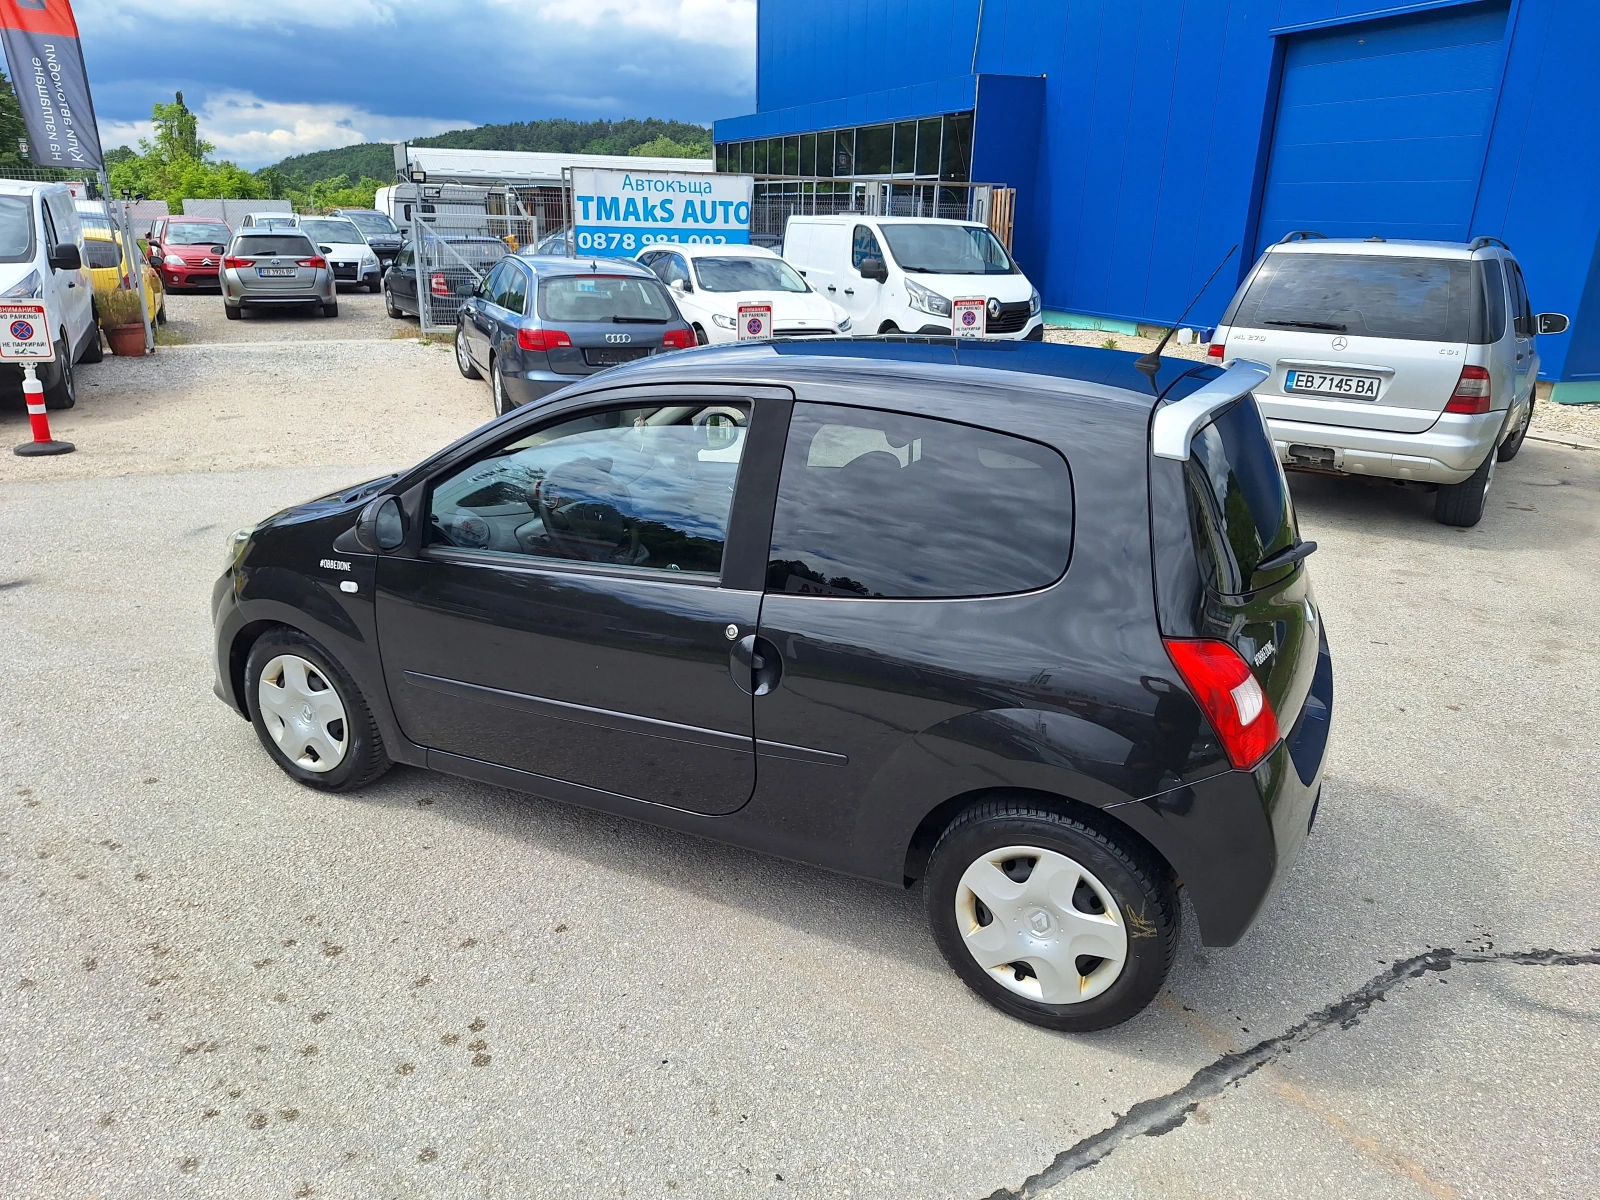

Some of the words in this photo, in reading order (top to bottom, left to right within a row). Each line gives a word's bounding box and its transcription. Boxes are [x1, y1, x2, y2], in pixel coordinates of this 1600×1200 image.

[622, 174, 712, 196] Автокъща
[577, 195, 675, 223] TMAkS
[682, 199, 749, 225] AUTO
[577, 232, 636, 250] 0878
[1316, 375, 1353, 392] 7145
[1355, 379, 1374, 395] BA
